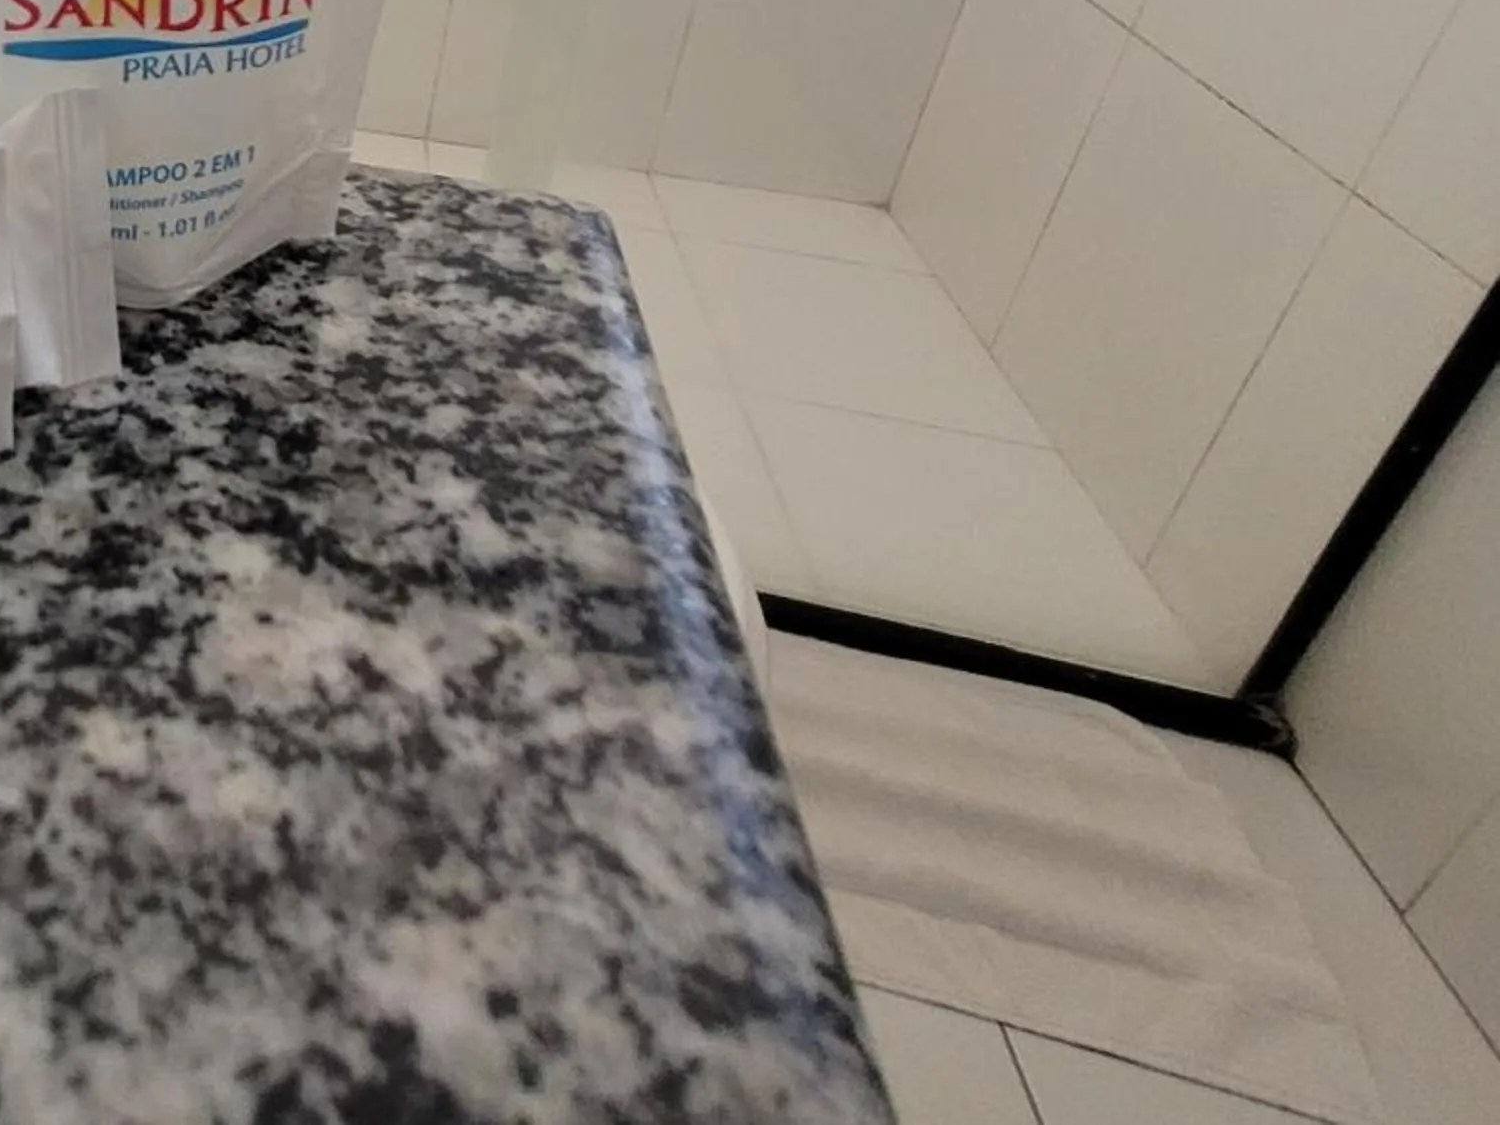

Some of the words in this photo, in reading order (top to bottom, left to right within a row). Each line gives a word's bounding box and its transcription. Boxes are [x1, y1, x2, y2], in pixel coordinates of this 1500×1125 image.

[123, 52, 214, 83] PRAIA
[226, 34, 306, 72] HOTEL
[193, 159, 206, 178] 2
[211, 150, 242, 174] EM
